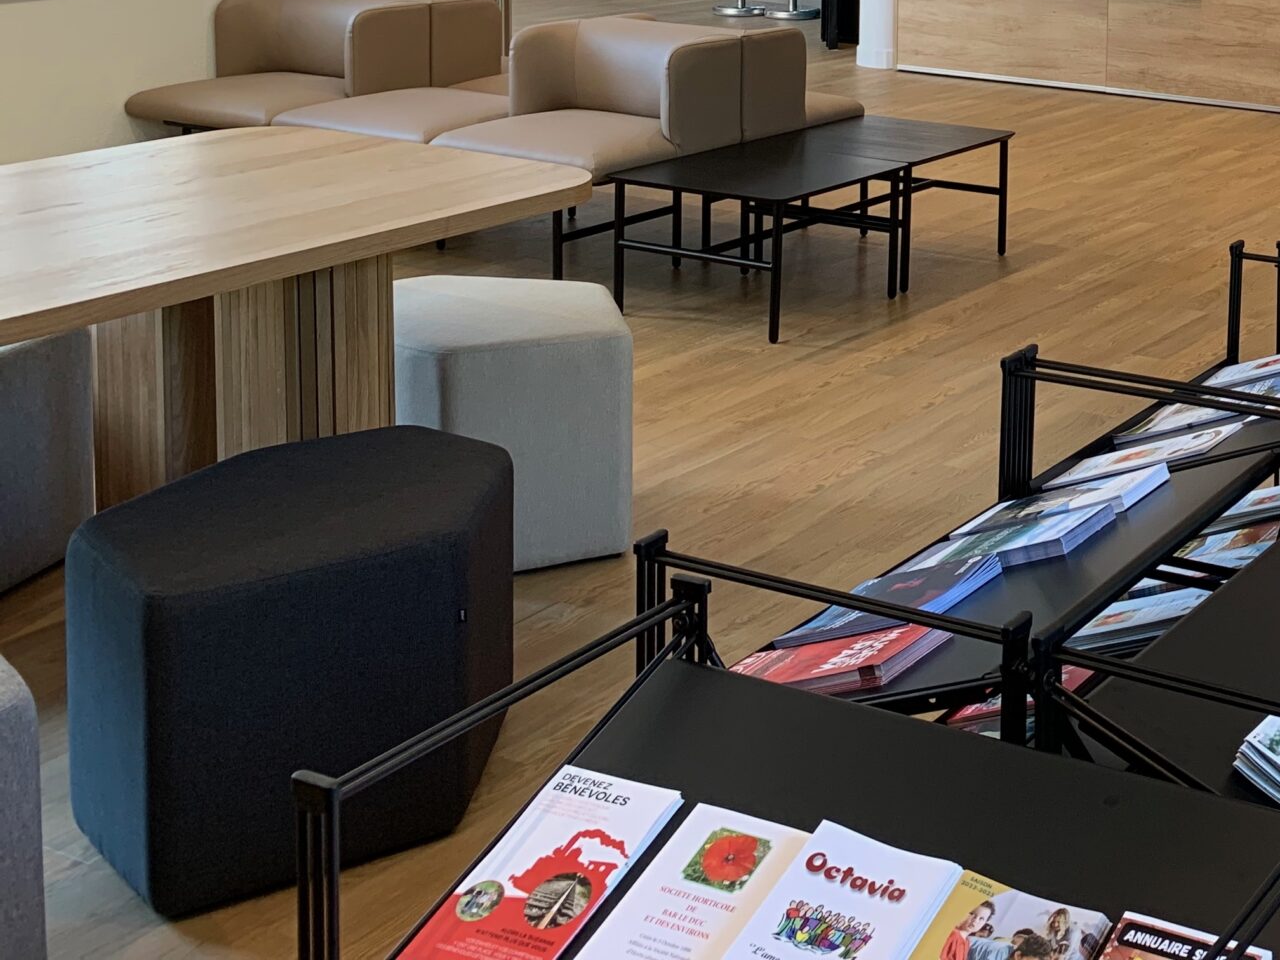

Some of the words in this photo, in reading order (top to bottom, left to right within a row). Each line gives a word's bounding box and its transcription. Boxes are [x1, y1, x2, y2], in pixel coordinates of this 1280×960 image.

[553, 781, 631, 806] BÉNÉVOLES
[562, 773, 613, 790] DEVENEZ
[805, 852, 906, 902] Octavia
[1124, 929, 1192, 958] ANNUAIRE
